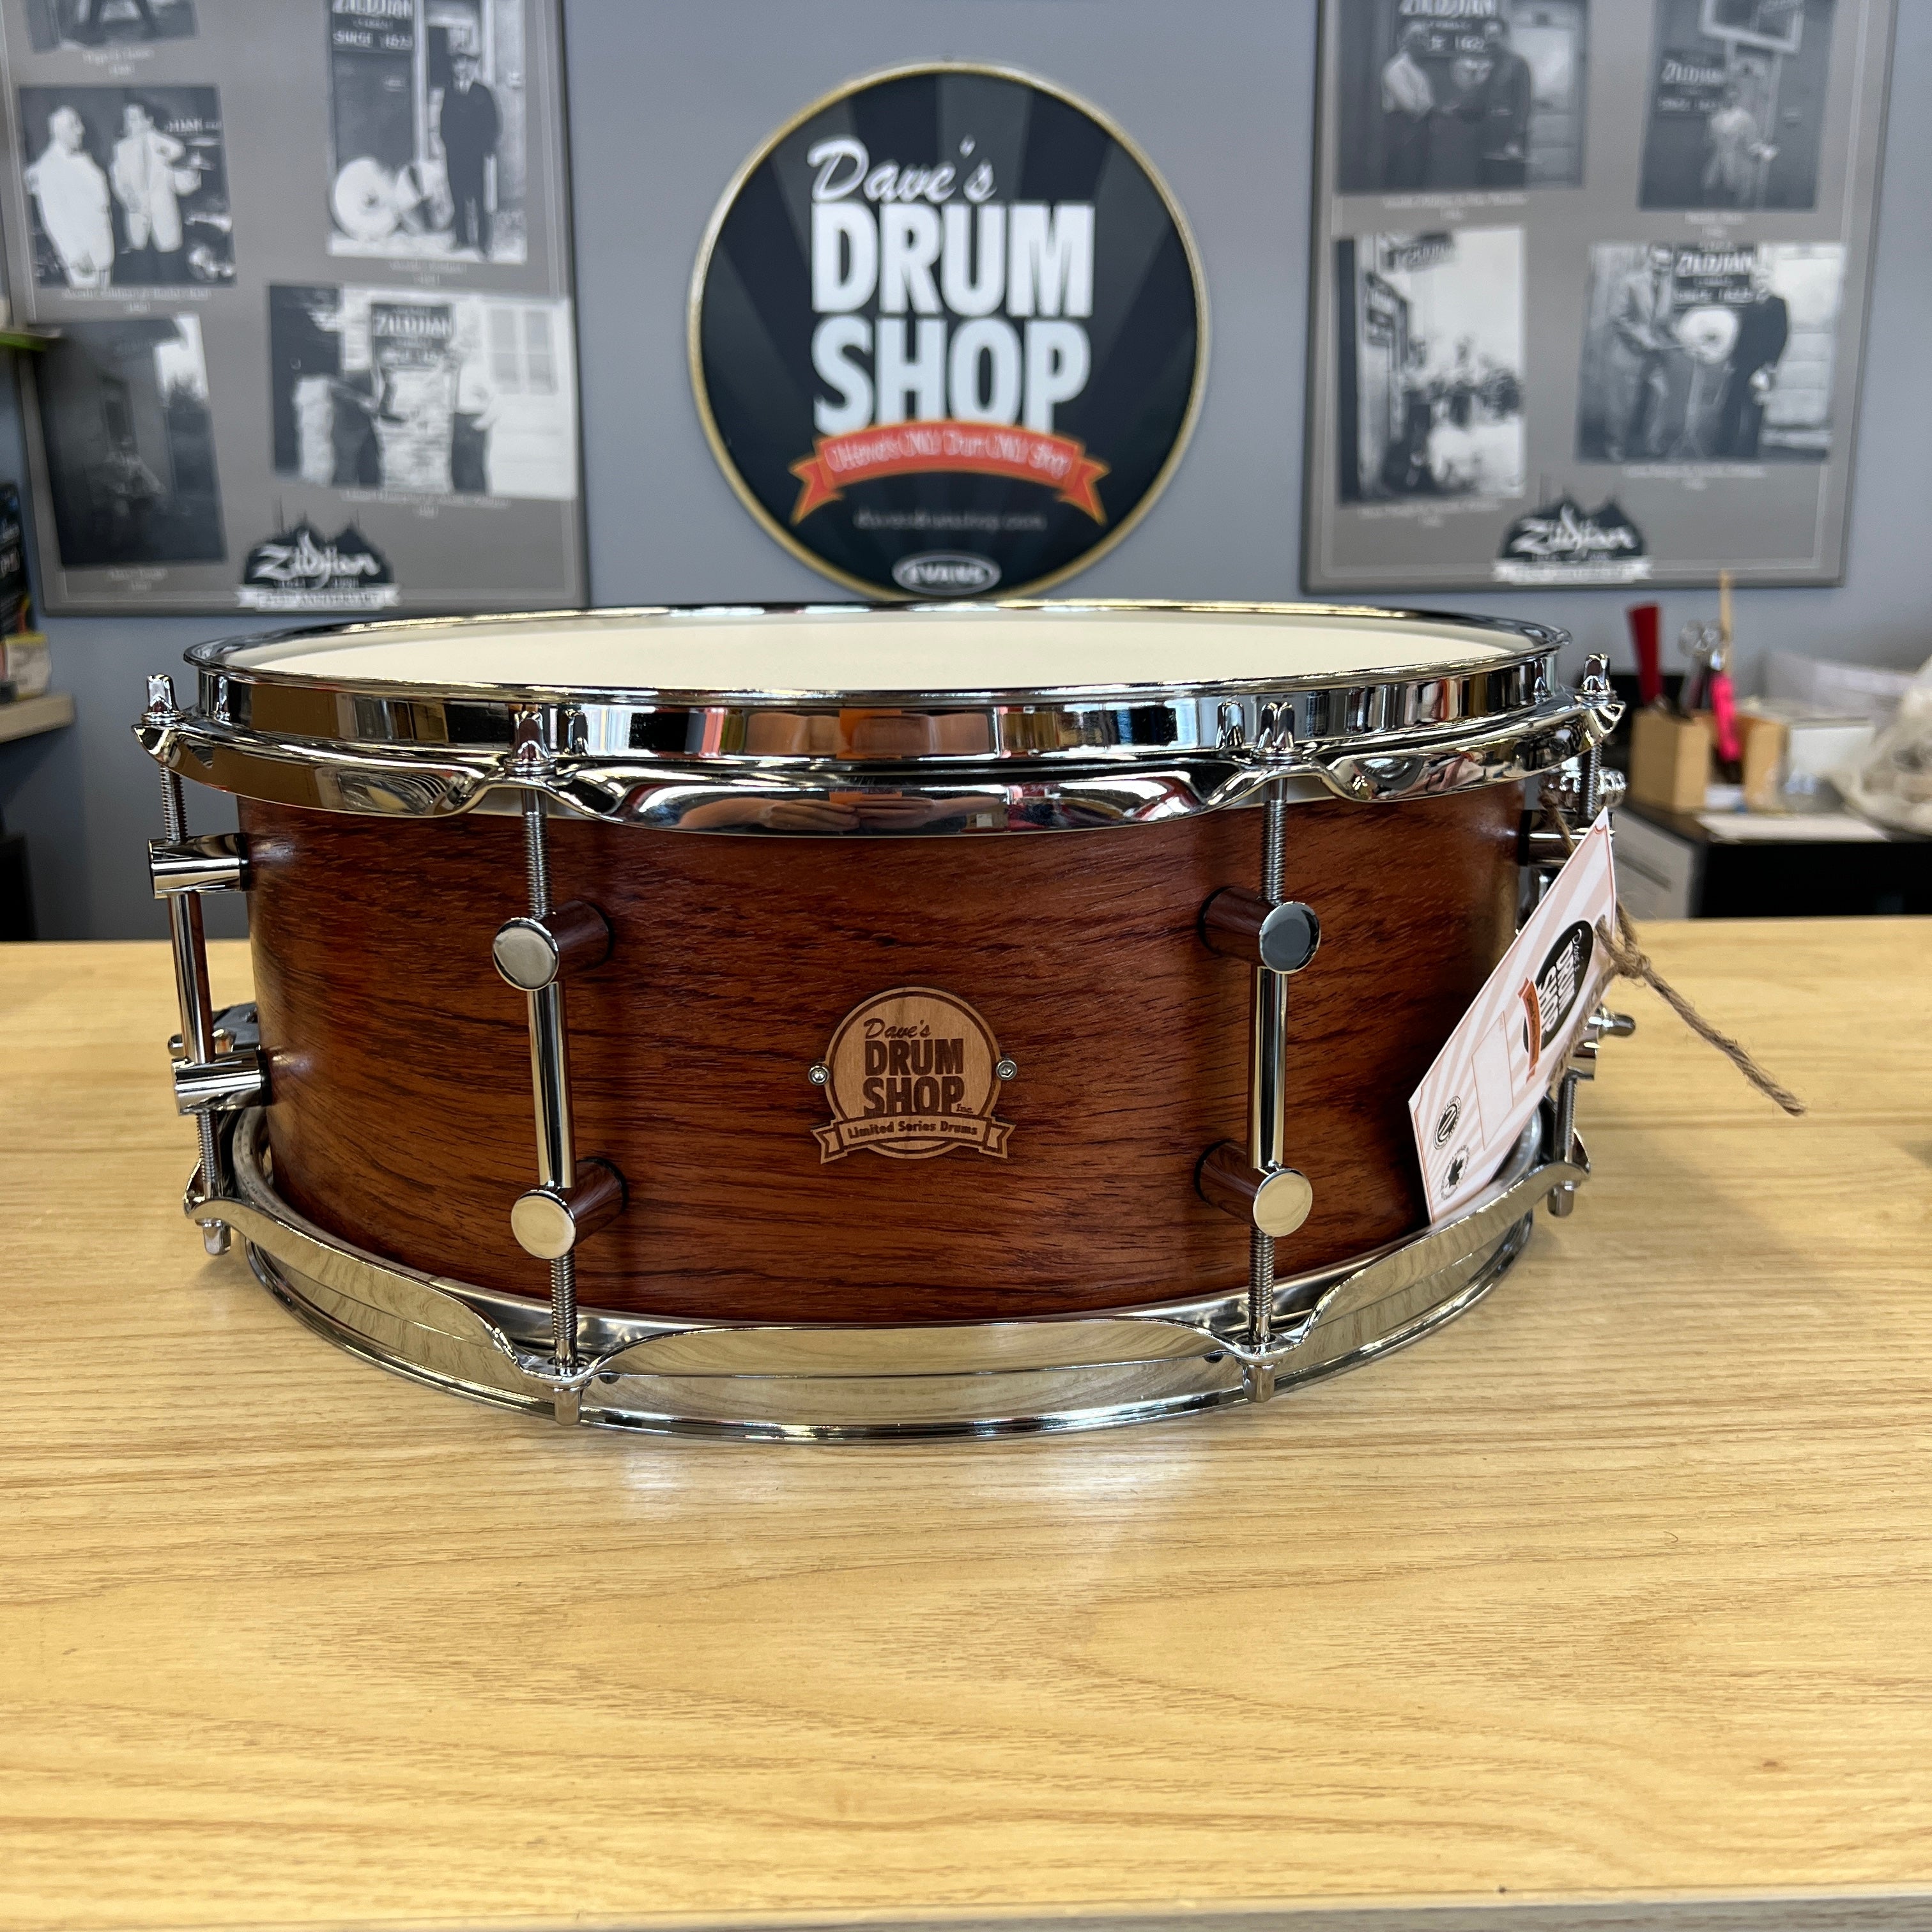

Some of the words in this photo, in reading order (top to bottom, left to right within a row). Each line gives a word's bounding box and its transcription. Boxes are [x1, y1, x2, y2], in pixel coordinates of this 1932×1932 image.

[807, 134, 997, 203] Dave's
[811, 201, 1095, 318] DRUM
[811, 315, 1092, 437] SHOP
[1537, 965, 1559, 1032] SHOP
[1556, 940, 1575, 1015] DRUM
[864, 1018, 931, 1039] Dave's
[864, 1038, 964, 1076] DRUM
[847, 1121, 894, 1139] Limited
[898, 1120, 936, 1133] Series
[940, 1121, 978, 1136] Drums
[863, 1076, 965, 1117] SHOP
